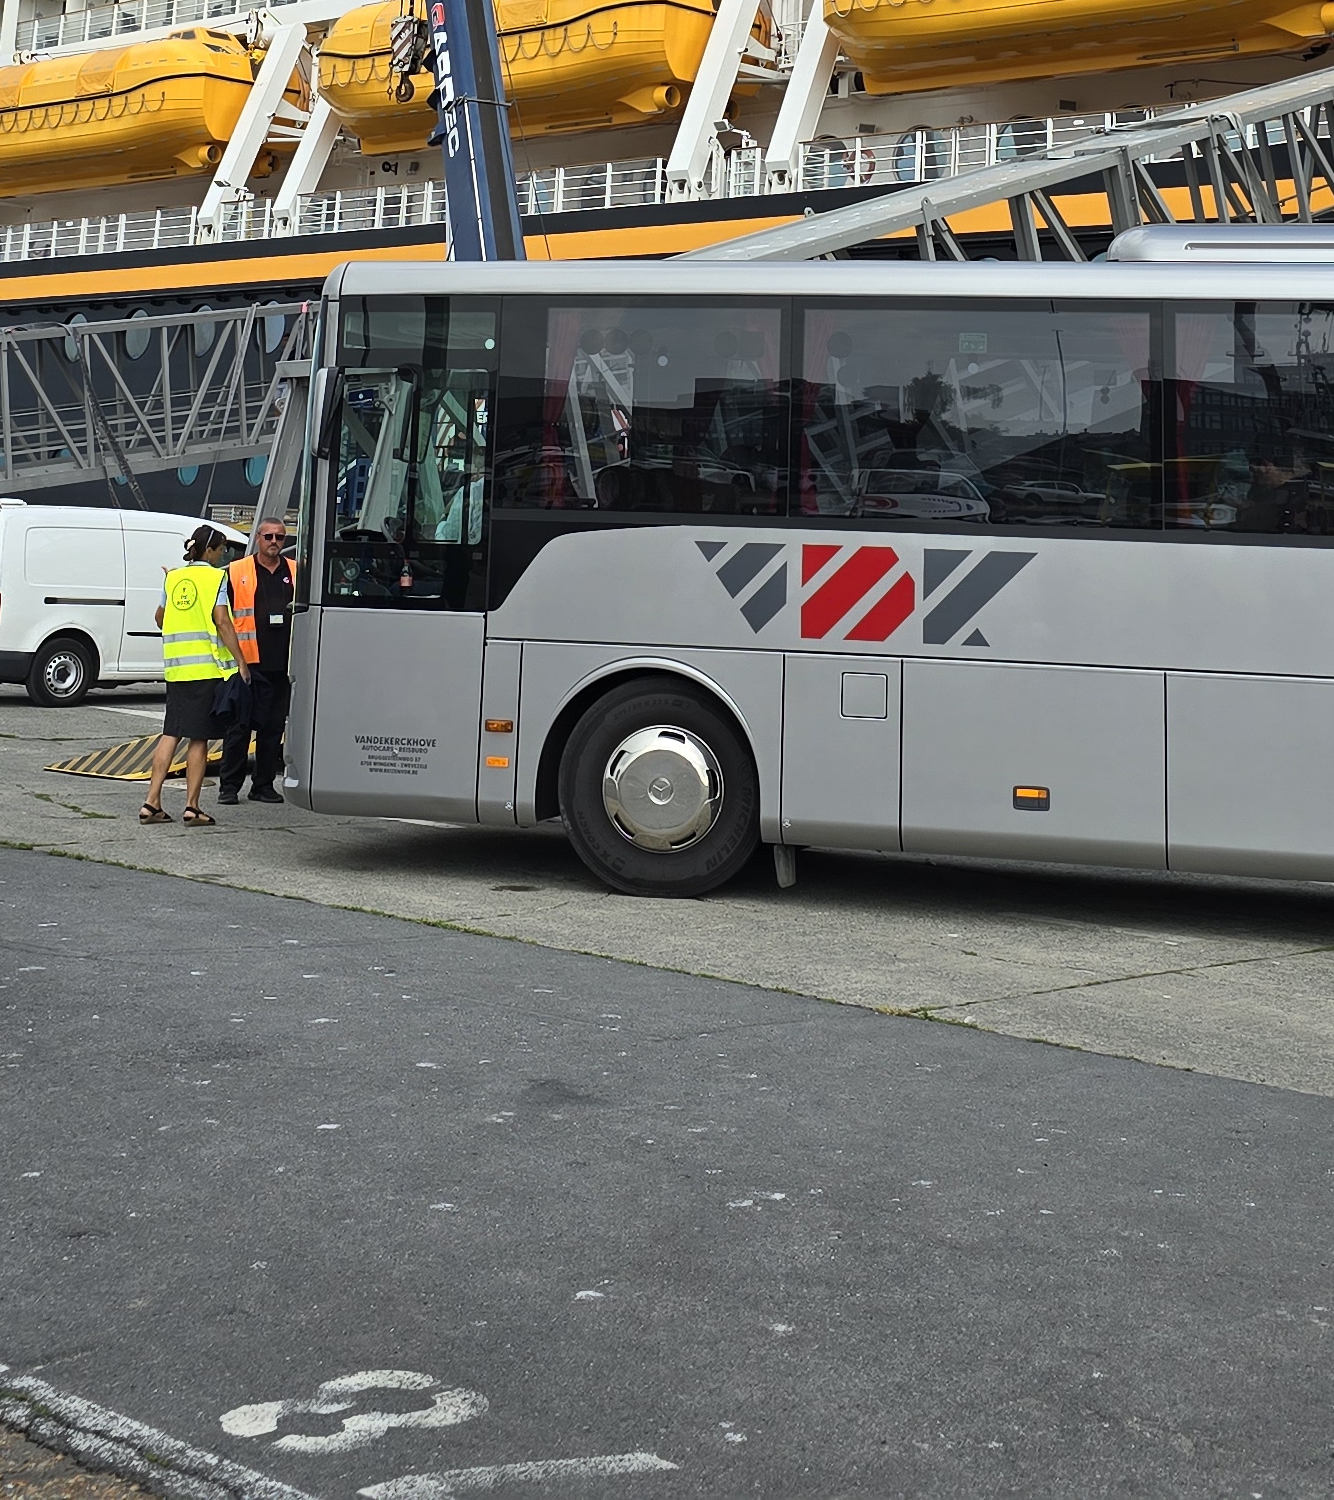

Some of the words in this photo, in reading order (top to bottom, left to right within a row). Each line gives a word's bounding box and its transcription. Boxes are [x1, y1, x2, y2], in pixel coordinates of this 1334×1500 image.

[354, 735, 437, 748] VANDEKERCKHOVE
[361, 745, 394, 753] AUTOCARS
[705, 787, 752, 872] MICHELIN
